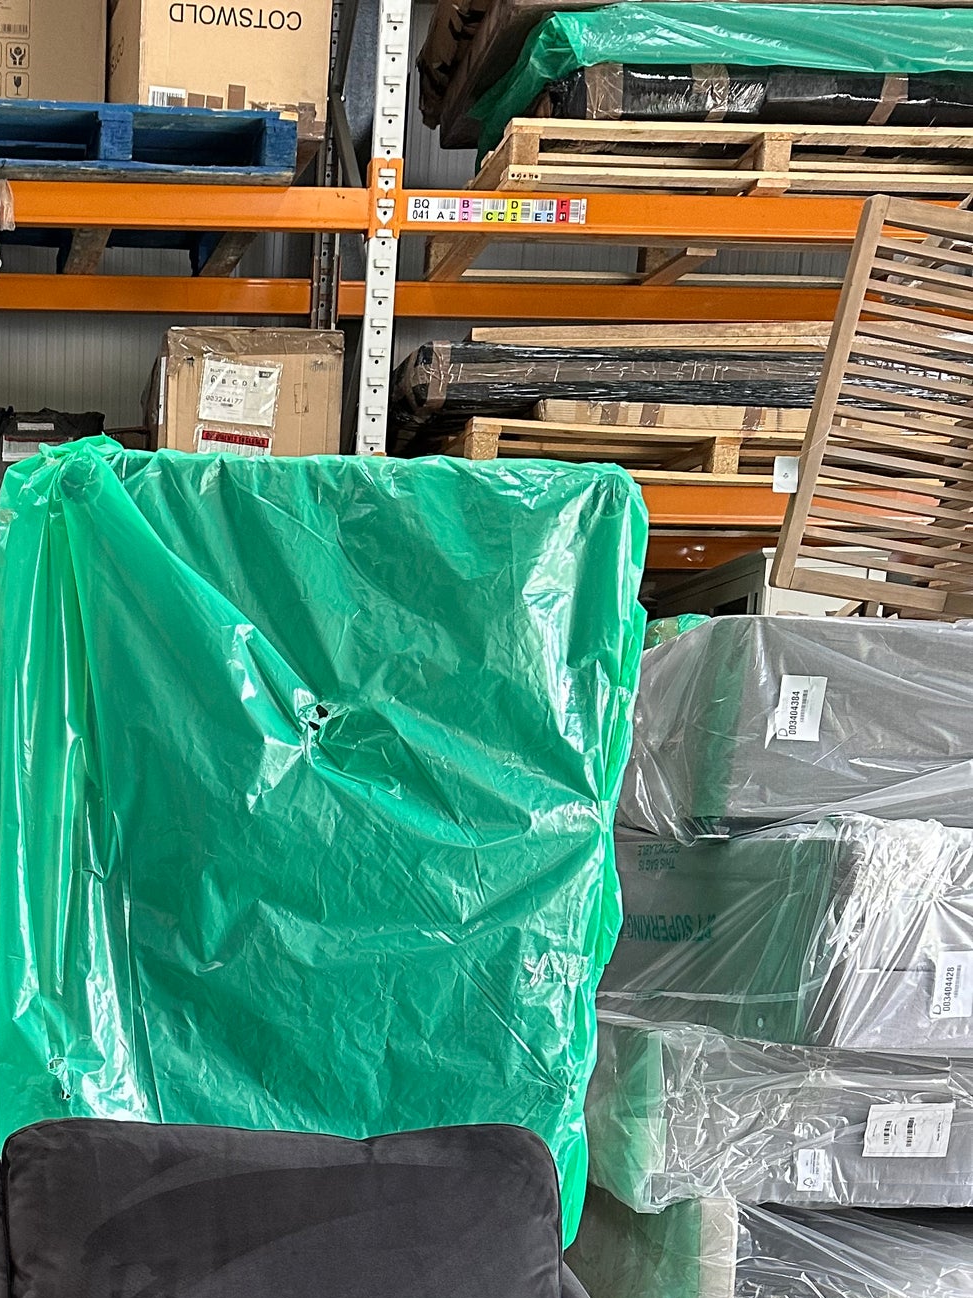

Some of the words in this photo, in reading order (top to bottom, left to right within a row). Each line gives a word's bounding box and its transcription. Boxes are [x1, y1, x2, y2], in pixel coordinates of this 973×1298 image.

[169, 3, 302, 31] COTSWOLD
[412, 210, 429, 220] 041
[436, 212, 445, 220] A
[485, 211, 493, 221] C
[534, 212, 542, 221] E
[413, 198, 430, 209] BQ
[462, 200, 470, 209] B
[511, 200, 519, 209] D
[560, 200, 567, 209] F
[788, 691, 800, 735] 003404384
[627, 913, 694, 942] SUPERKING
[942, 966, 955, 1012] 003404428
